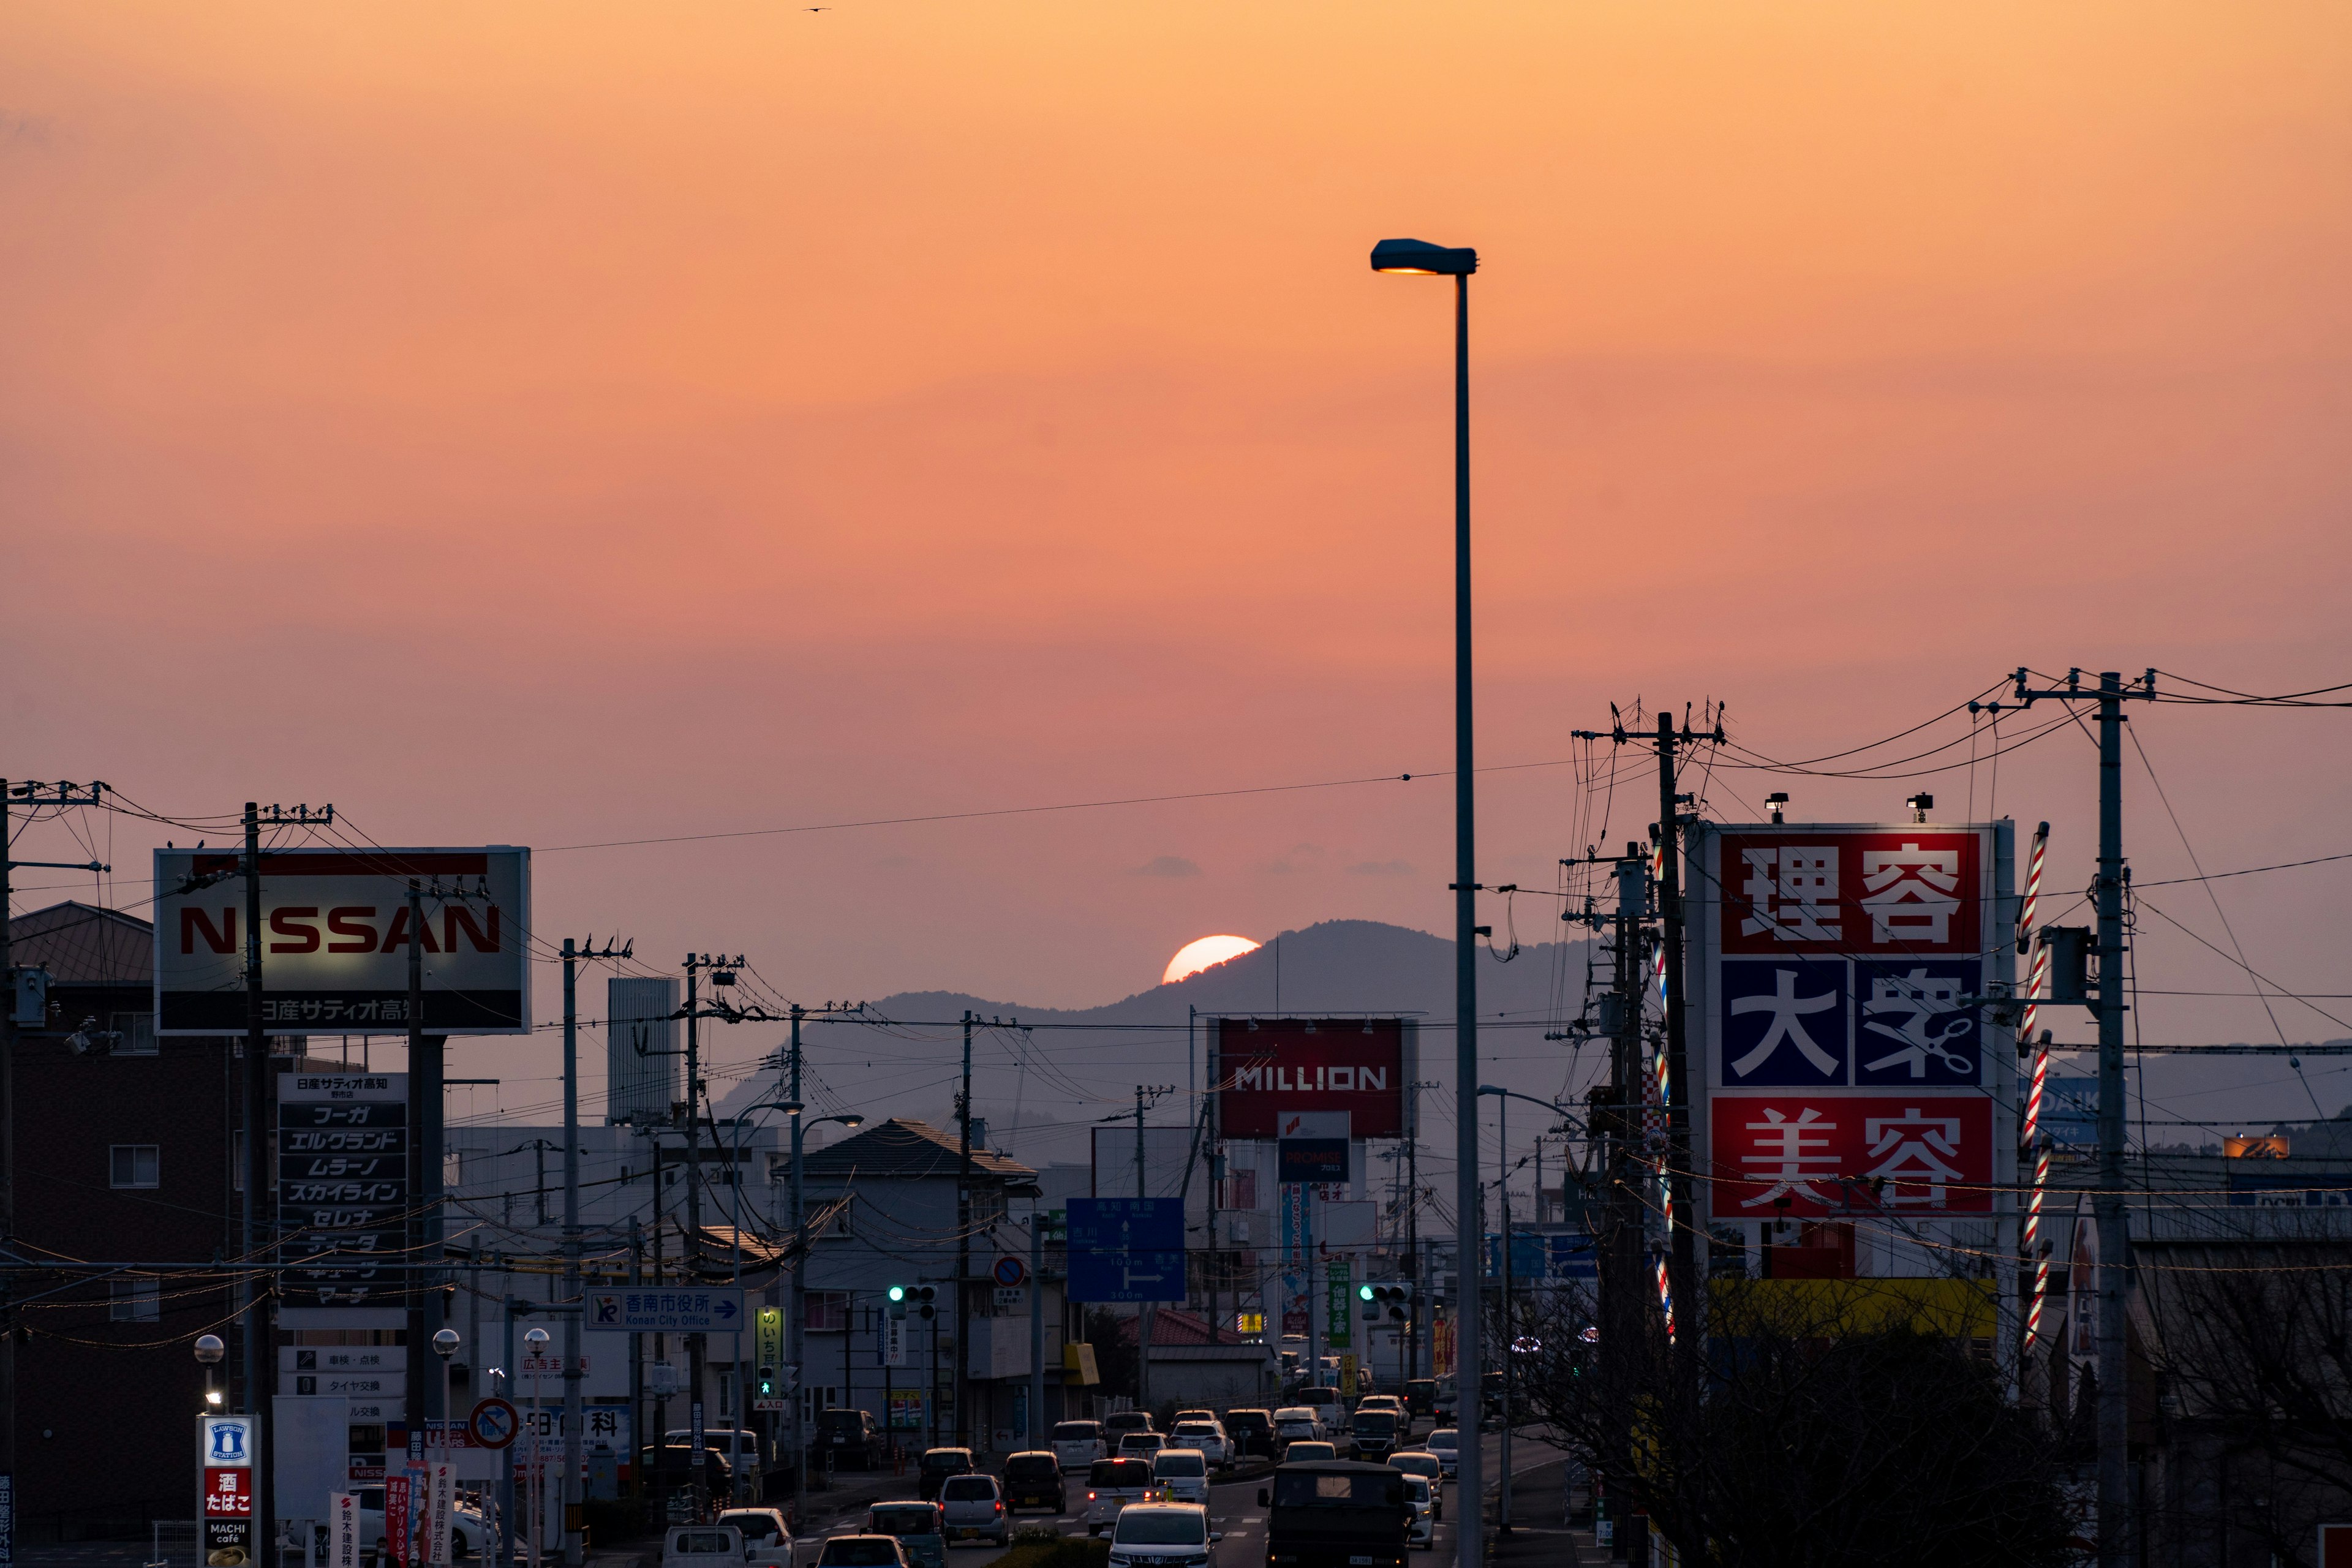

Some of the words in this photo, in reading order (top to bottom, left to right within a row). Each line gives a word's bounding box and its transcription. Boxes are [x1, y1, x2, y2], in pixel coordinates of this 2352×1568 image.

[1741, 843, 1962, 944] 理容
[181, 907, 500, 954] NSSAN
[297, 1078, 388, 1090] 日産サティオ高知
[1235, 1066, 1387, 1091] MILLION
[314, 1106, 371, 1125] フーガ
[288, 1132, 398, 1150] エルグランド
[1286, 1150, 1342, 1164] PROMISE
[1741, 1107, 1965, 1208] 美容
[307, 1158, 380, 1176] ムラーノ
[288, 1184, 398, 1201] スカイライン
[1096, 1201, 1121, 1211] 高知
[1129, 1201, 1154, 1211] 南国
[313, 1210, 373, 1226] セレナ
[1072, 1227, 1098, 1237] 吉川
[1154, 1254, 1180, 1264] 香美
[626, 1294, 710, 1313] 香南市役所
[626, 1315, 655, 1325] Konan
[659, 1315, 677, 1327] City
[682, 1315, 710, 1325] Office
[329, 1355, 380, 1366] 車検・点検
[330, 1381, 380, 1392] タイヤ交換
[349, 1407, 380, 1417] ル交換
[692, 1403, 703, 1451] 藤田整形外科
[218, 1473, 238, 1493] 酒
[206, 1494, 251, 1512] たばこ
[396, 1482, 407, 1562] 思いやりの心で
[432, 1478, 447, 1562] 鈴木建設株式会社
[211, 1525, 245, 1534] MACHI
[216, 1535, 239, 1544] café
[341, 1510, 353, 1568] 鈴木建設株
